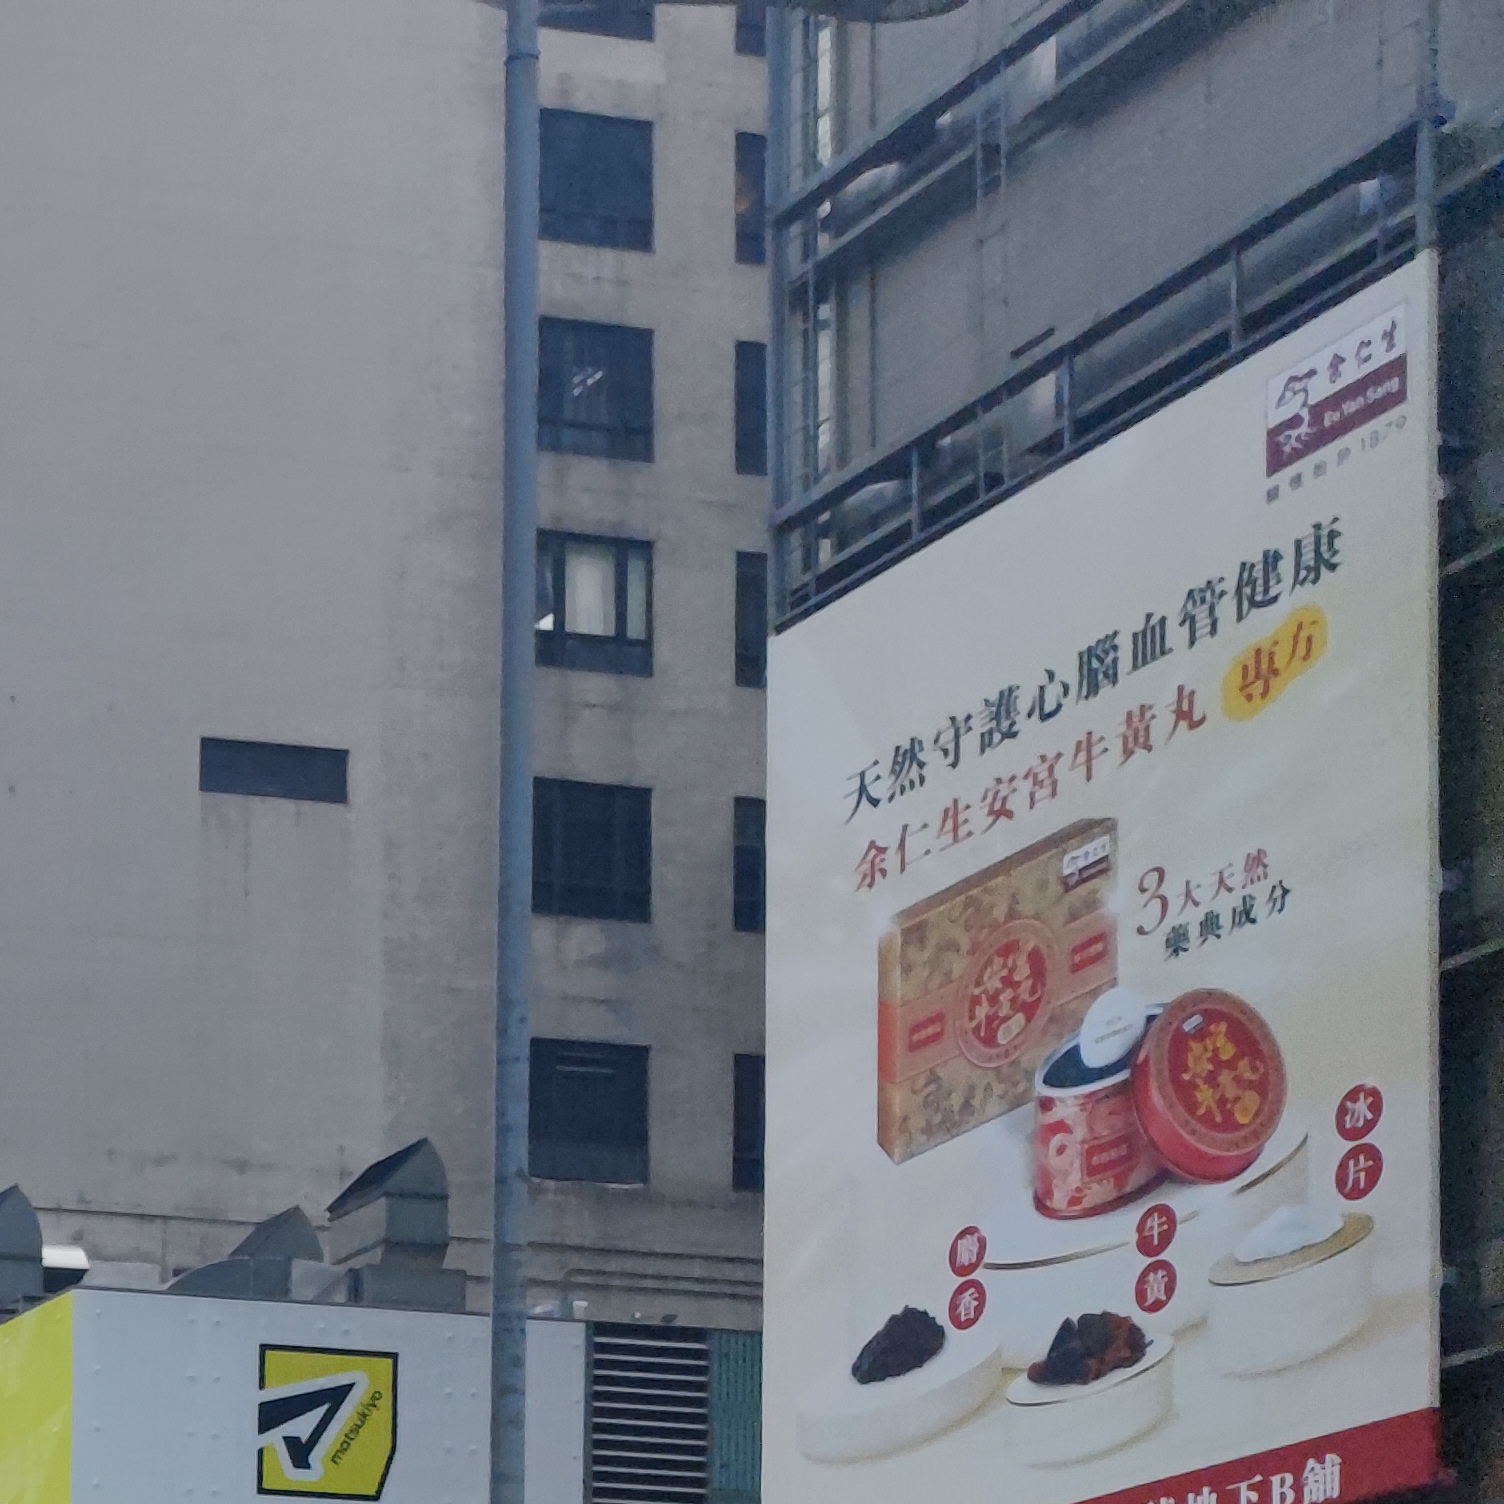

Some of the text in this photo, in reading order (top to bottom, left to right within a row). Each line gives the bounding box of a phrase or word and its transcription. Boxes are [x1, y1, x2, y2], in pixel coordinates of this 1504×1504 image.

[843, 514, 1344, 825] 天然守護心腦血管健康
[854, 616, 1321, 892] 余仁生安宮牛黃丸 專方
[330, 1390, 383, 1466] matsukiyo
